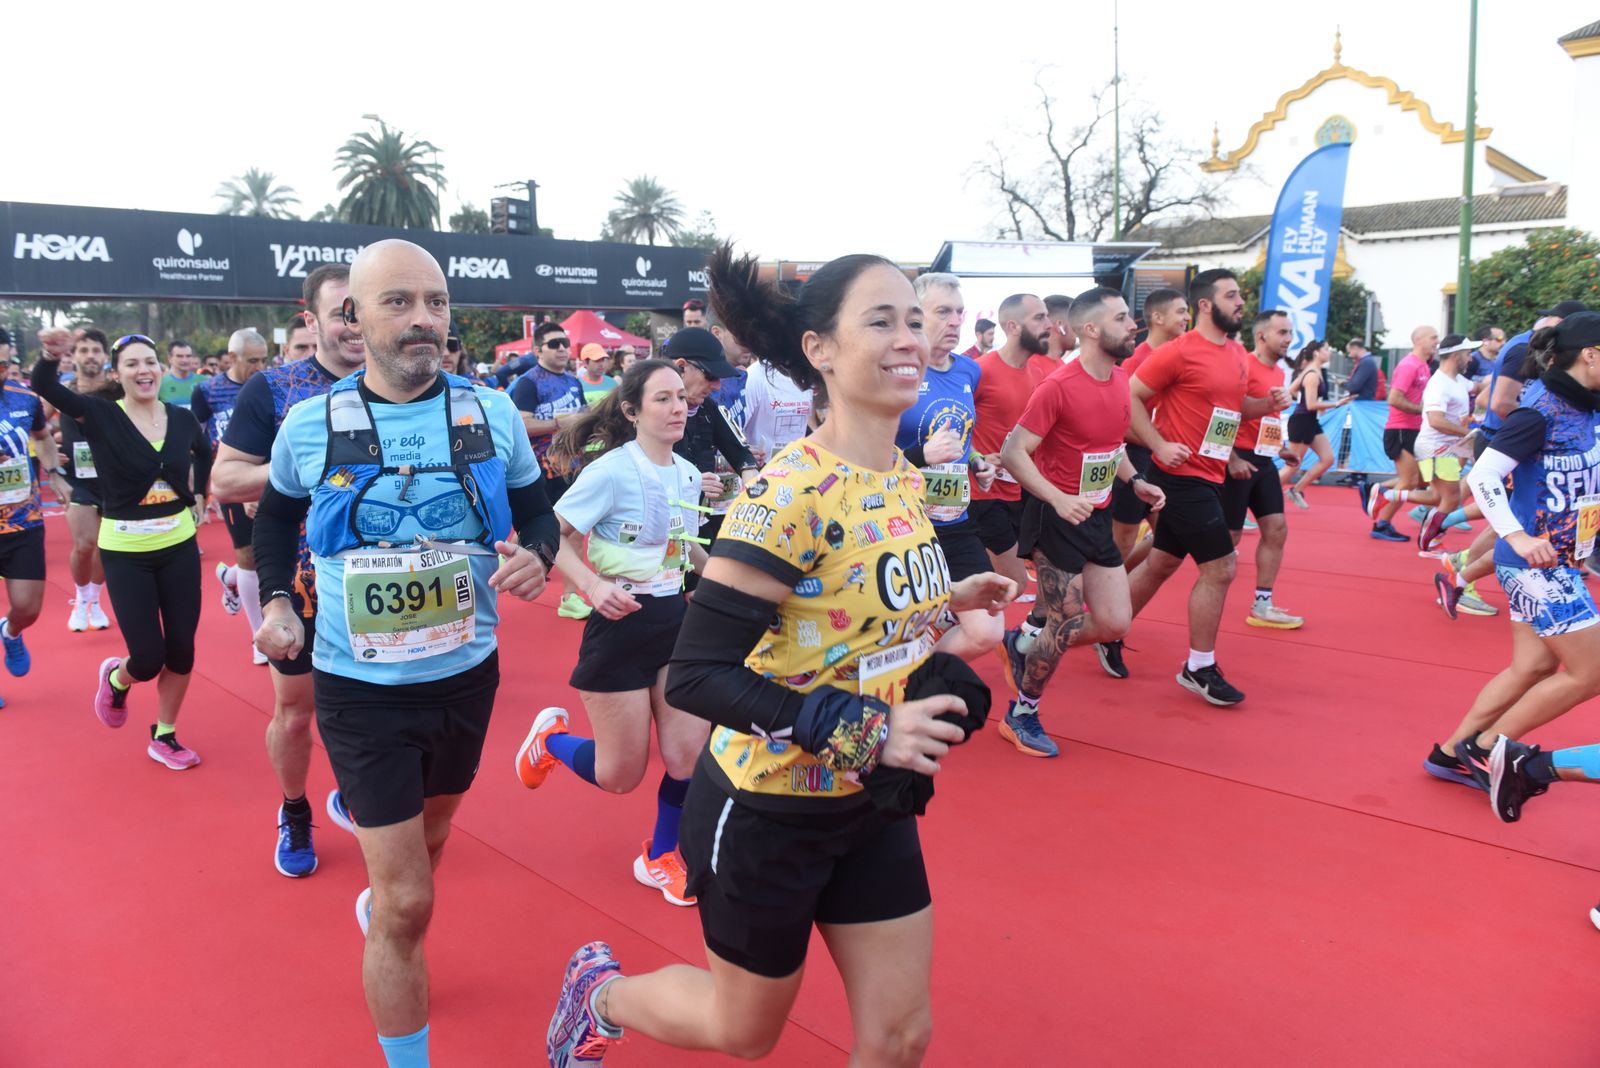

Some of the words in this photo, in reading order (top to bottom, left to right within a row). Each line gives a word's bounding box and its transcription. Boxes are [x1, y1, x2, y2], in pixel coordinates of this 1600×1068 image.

[1297, 190, 1319, 254] HUMAN
[14, 233, 113, 262] HOKA
[1283, 226, 1299, 254] FLY
[1311, 228, 1328, 254] FLY
[199, 273, 224, 281] Partner
[448, 256, 511, 279] HOKA
[554, 267, 598, 277] HYUNDAI
[1272, 257, 1325, 360] OKA
[400, 434, 426, 449] edp
[390, 450, 421, 462] media
[464, 451, 490, 460] EVADICT
[1544, 454, 1583, 471] MEDIO
[925, 478, 959, 497] 7451
[731, 503, 777, 529] CORRE
[1583, 510, 1600, 530] 12
[853, 519, 885, 548] RUN
[351, 558, 370, 568] MEDIO
[371, 555, 403, 568] MARATÓN
[420, 549, 454, 568] SEVILLA
[877, 537, 952, 612] CORR
[365, 576, 443, 616] 6391
[792, 764, 834, 793] RUN
